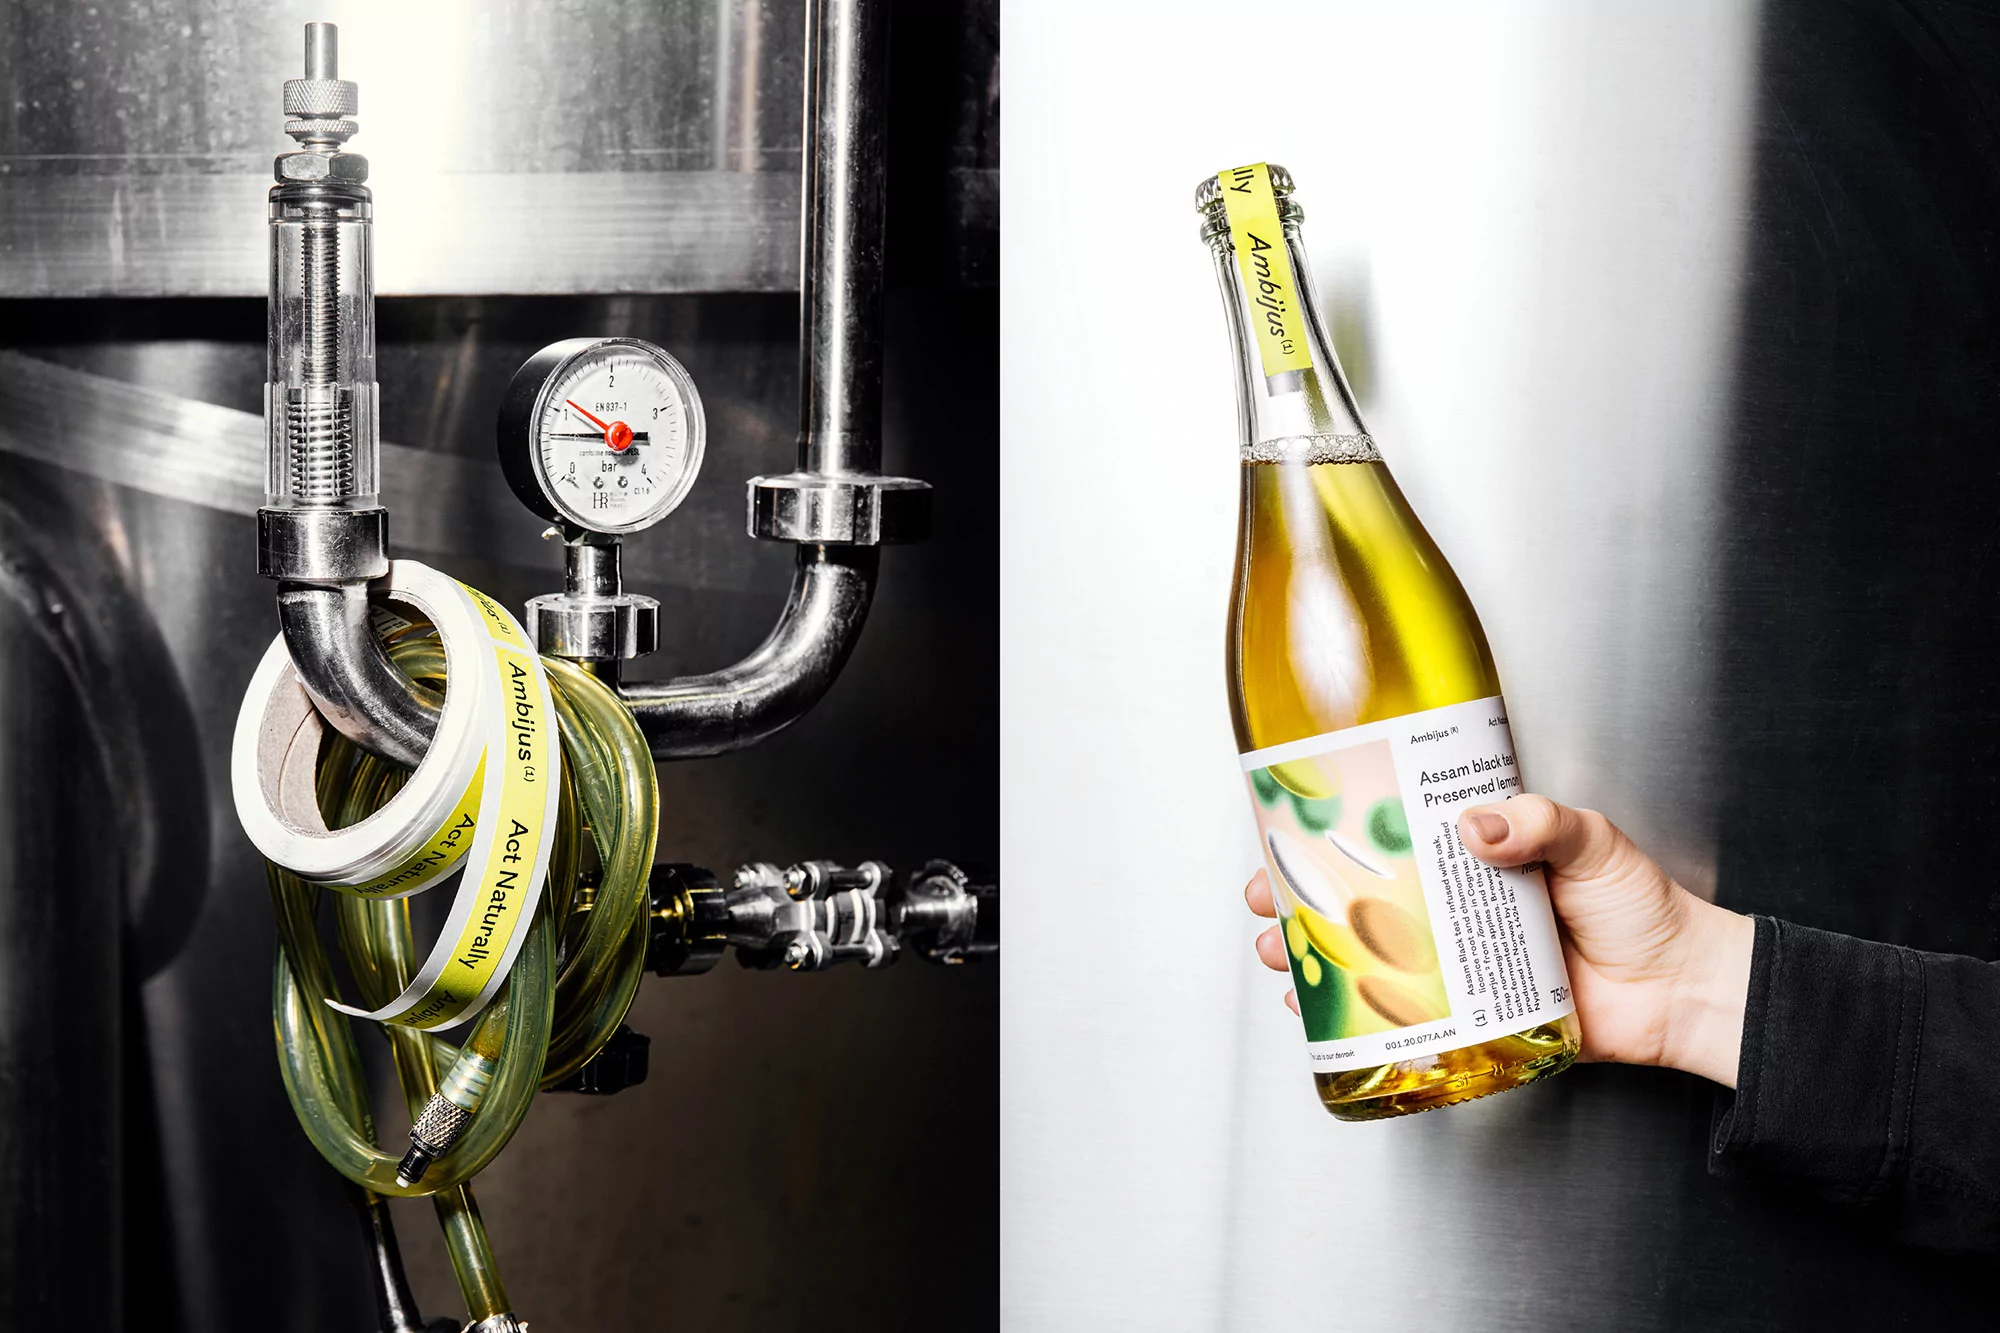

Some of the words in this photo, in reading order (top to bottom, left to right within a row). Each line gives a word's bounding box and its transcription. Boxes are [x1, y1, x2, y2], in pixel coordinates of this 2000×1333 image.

[1247, 232, 1286, 337] Ambijus
[1280, 340, 1295, 355] (1)
[609, 375, 614, 387] 2
[564, 409, 568, 420] 1
[595, 403, 604, 412] EN
[606, 402, 627, 411] 837-1
[653, 407, 658, 420] 3
[570, 461, 576, 474] 0
[601, 460, 617, 472] bar
[641, 464, 647, 475] 4
[508, 661, 535, 761] Ambijus
[1410, 729, 1449, 745] Ambijus
[523, 766, 535, 782] (1)
[1420, 765, 1470, 786] Assam
[1471, 754, 1502, 773] black
[1502, 753, 1514, 767] tea
[1423, 778, 1495, 807] Preserved
[440, 813, 475, 848] Act
[502, 818, 529, 864] Act
[1440, 821, 1455, 860] Blended
[354, 850, 447, 894] Naturally
[1437, 858, 1448, 877] with
[1476, 872, 1484, 888] the
[1442, 879, 1456, 913] infused
[1452, 861, 1468, 914] chamomile.
[1484, 867, 1497, 902] Brewed
[1498, 880, 1508, 905] Leske
[1471, 898, 1478, 908] in
[1479, 890, 1489, 907] and
[458, 870, 518, 970] Naturally
[1462, 916, 1473, 934] and
[1485, 908, 1497, 939] apples
[1495, 904, 1507, 940] lemons.
[1504, 907, 1511, 919] by
[1512, 905, 1521, 928] 1424
[1453, 920, 1462, 937] tea
[1507, 920, 1520, 956] Norway
[1455, 938, 1468, 963] Black
[1468, 936, 1477, 957] root
[1481, 940, 1491, 964] from
[1492, 942, 1508, 991] norwegian
[1515, 957, 1522, 967] in
[1463, 965, 1475, 996] Assam
[1474, 959, 1486, 994] licorice
[1488, 971, 1499, 1000] verjus
[1501, 942, 1524, 1017] lacto-fermented
[1522, 947, 1541, 1011] Nygårdsveien
[1518, 969, 1534, 1013] produced
[1473, 1009, 1488, 1027] (1)
[1494, 1002, 1504, 1022] with
[1504, 993, 1515, 1019] Crisp
[1385, 1028, 1457, 1051] 001.20.077.A.AN
